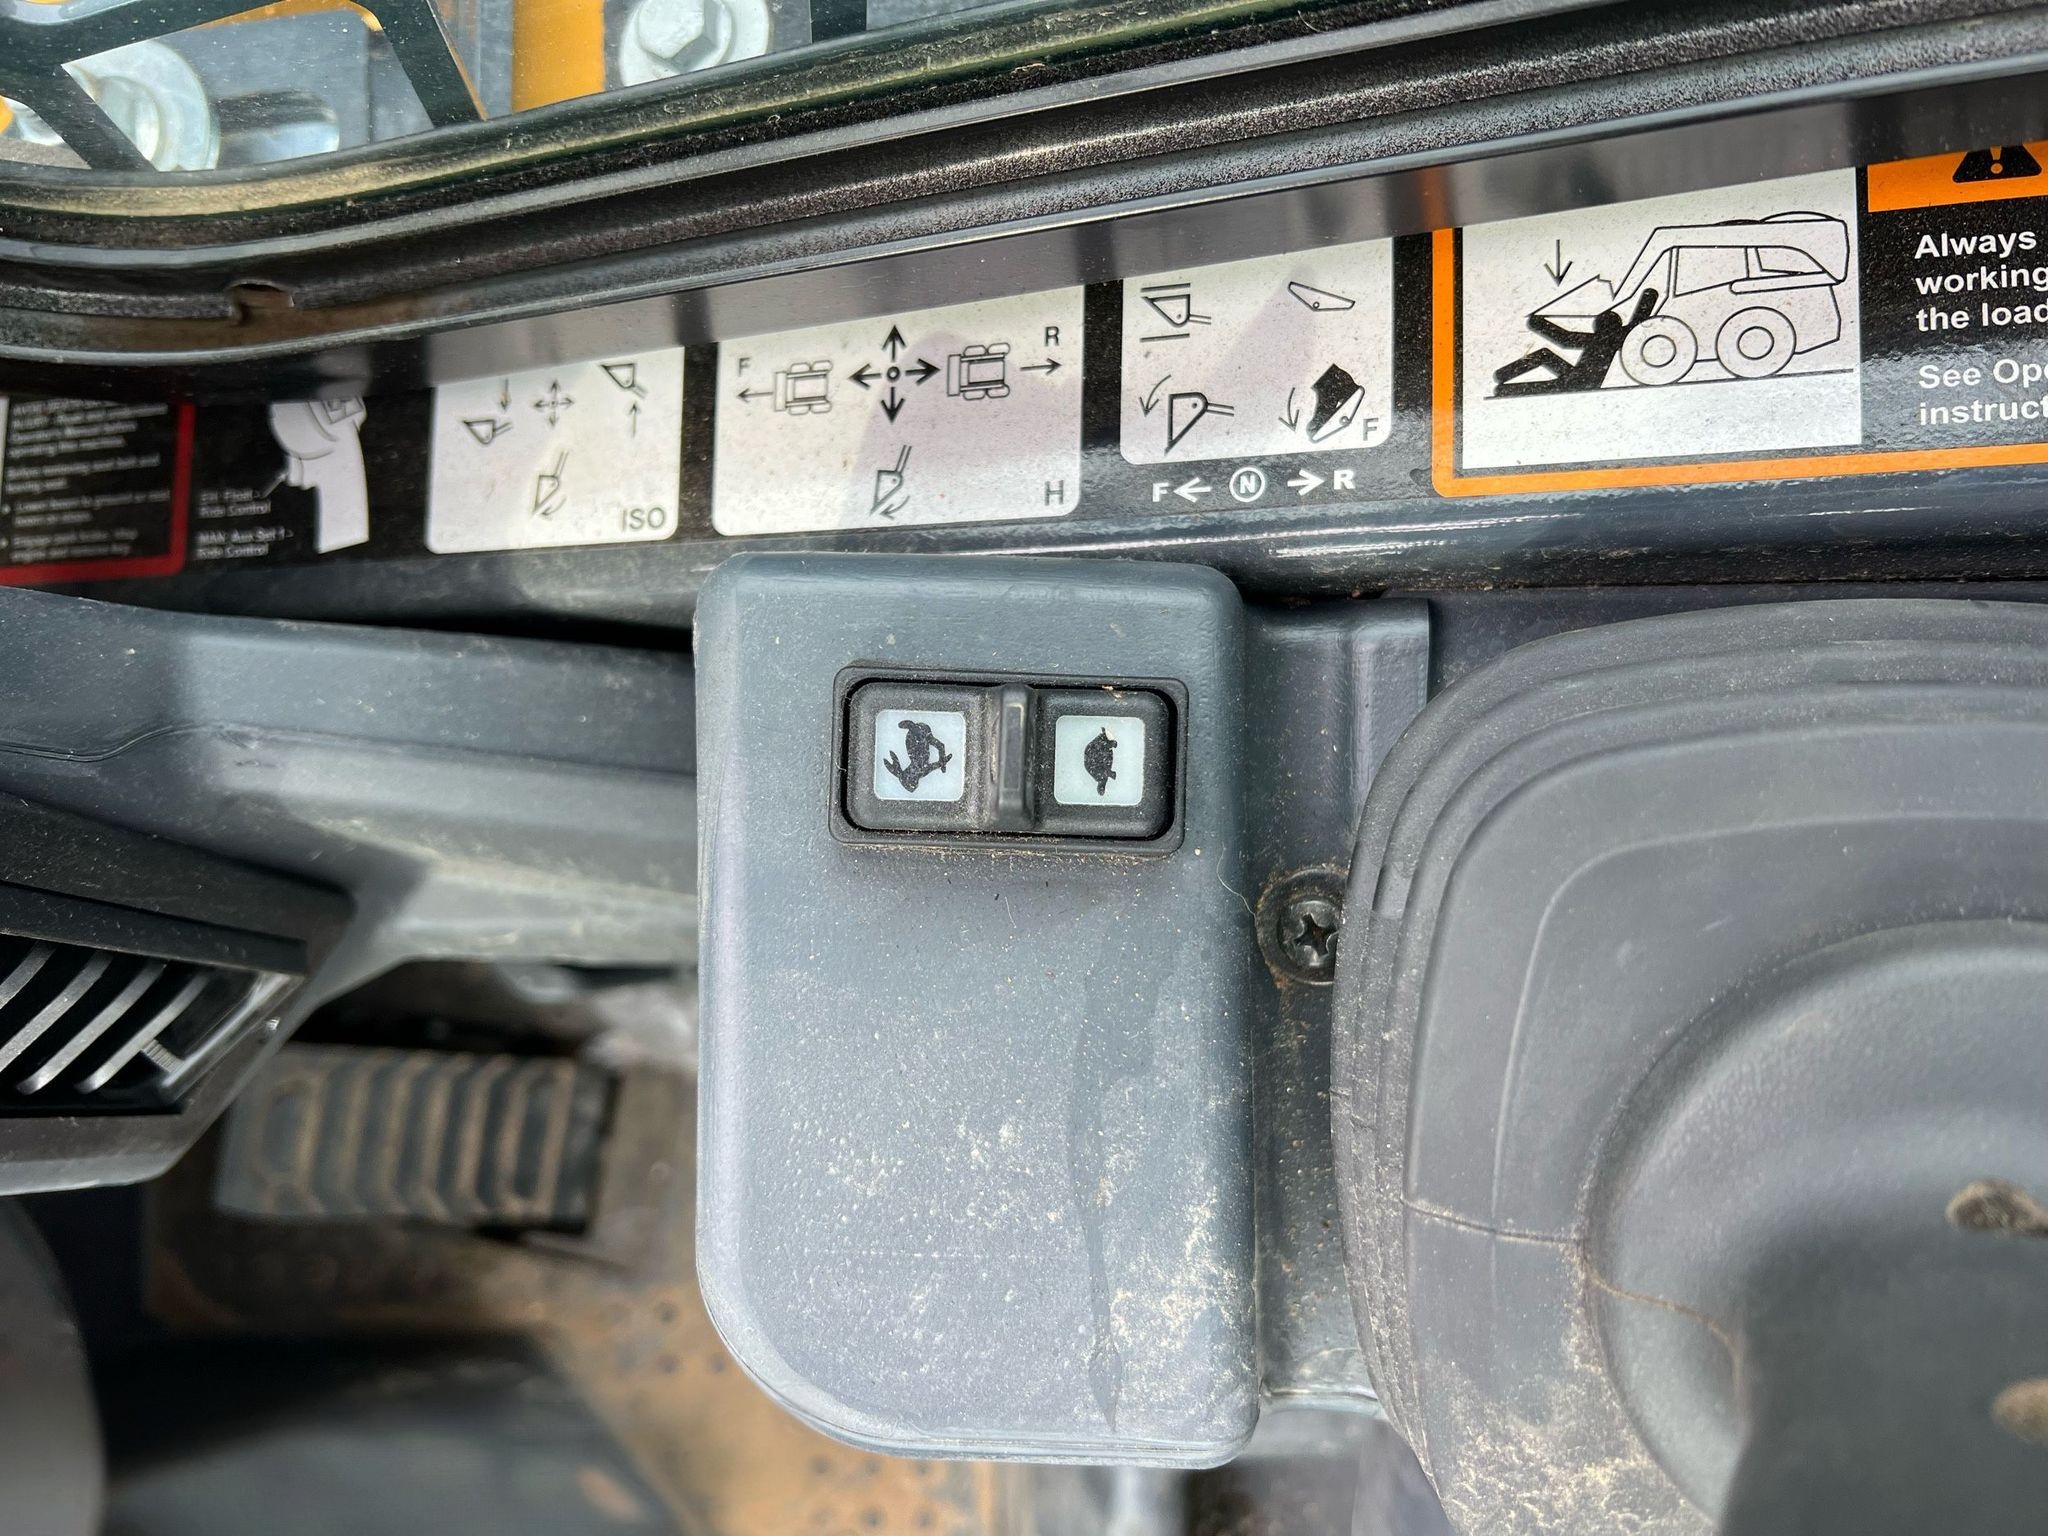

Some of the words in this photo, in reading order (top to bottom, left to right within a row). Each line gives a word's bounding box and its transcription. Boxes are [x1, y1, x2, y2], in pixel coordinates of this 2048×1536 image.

[1915, 231, 2037, 259] Always
[1915, 264, 2048, 295] working
[1916, 307, 1969, 332] the
[1044, 326, 1060, 347] R
[738, 357, 751, 377] F
[1919, 364, 1981, 389] See
[1362, 418, 1379, 441] F
[1044, 480, 1064, 506] H
[1152, 482, 1170, 502] F
[1239, 475, 1257, 494] N
[1333, 469, 1355, 490] R
[621, 507, 666, 532] ISO
